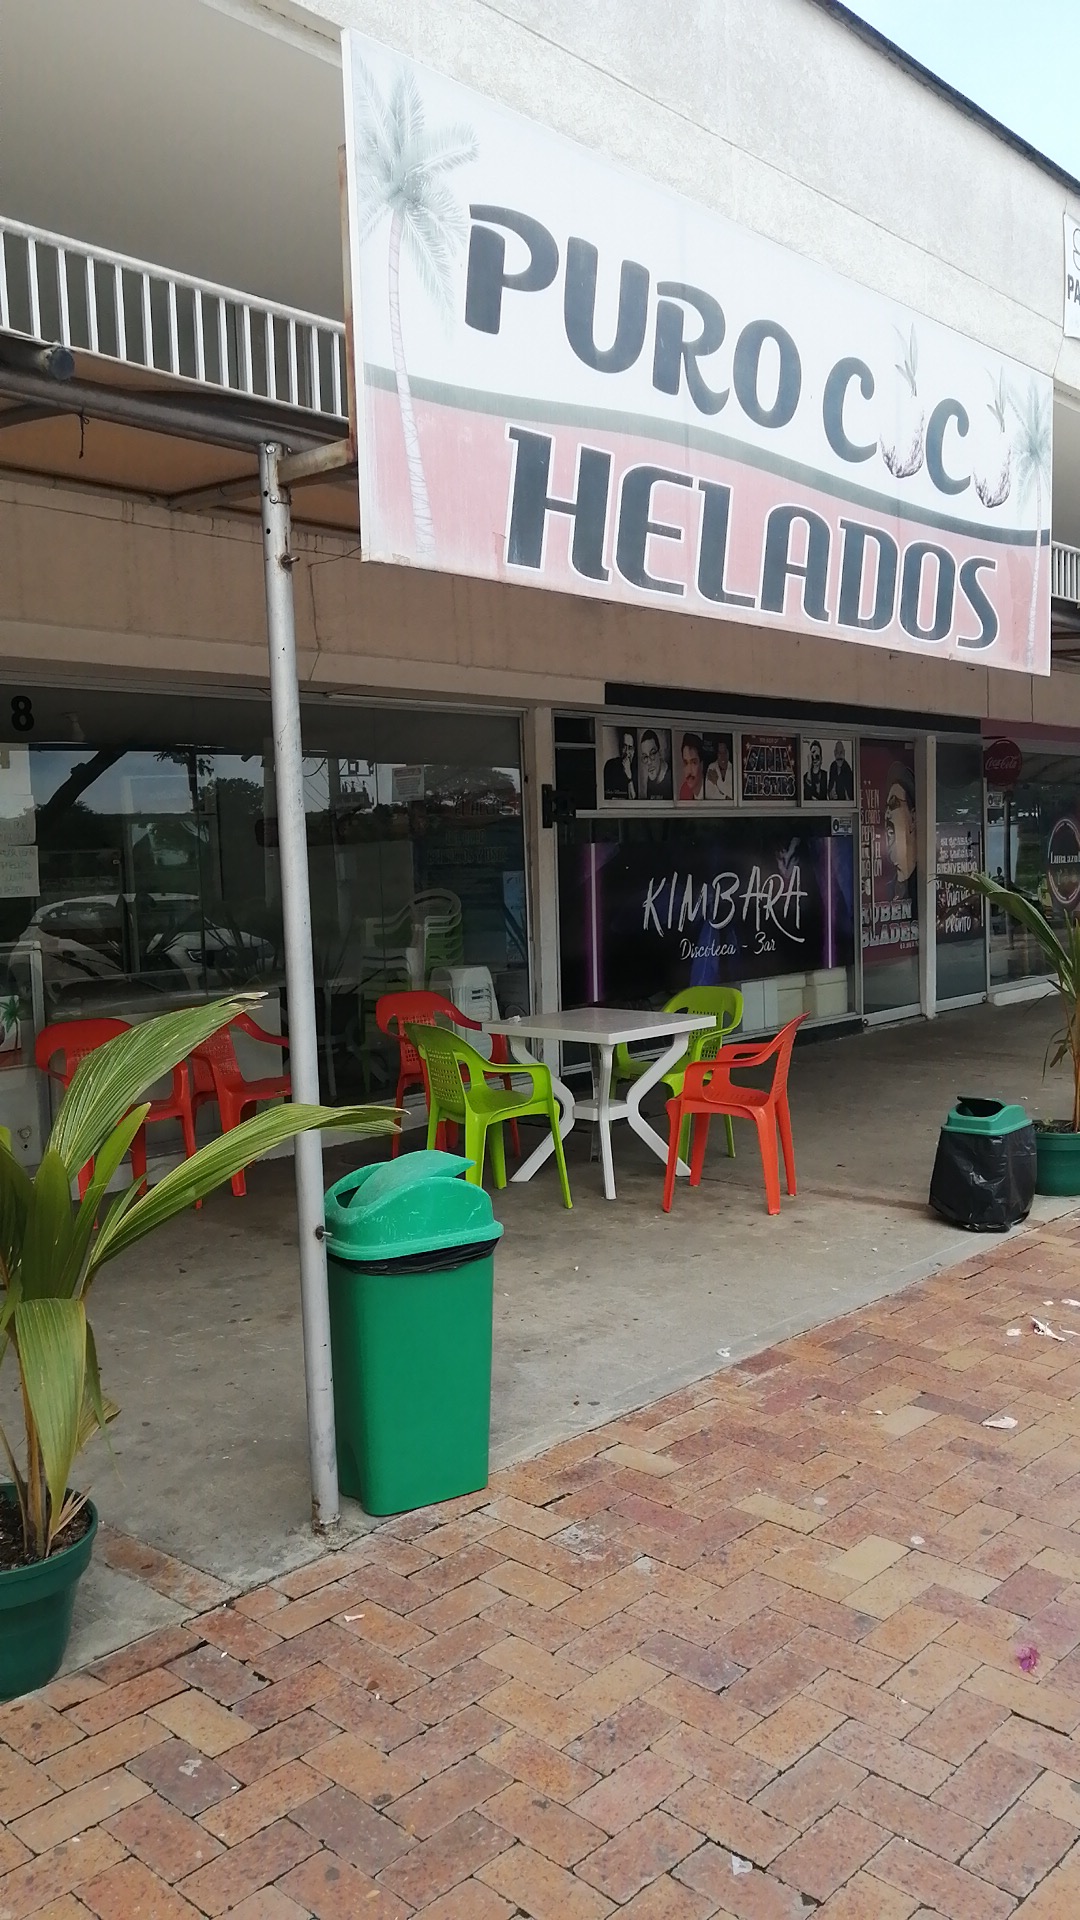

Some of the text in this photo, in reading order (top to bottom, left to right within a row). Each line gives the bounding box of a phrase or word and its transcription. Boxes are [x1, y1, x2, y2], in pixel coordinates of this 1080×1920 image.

[465, 204, 802, 429] PURO
[505, 422, 999, 650] HELADOS
[11, 695, 35, 732] 8
[984, 755, 1020, 771] Coca-Cola
[641, 865, 808, 943] KIMBARA
[679, 938, 737, 961] Discoteca
[753, 931, 777, 955] Bar
[860, 920, 919, 948] BLADES
